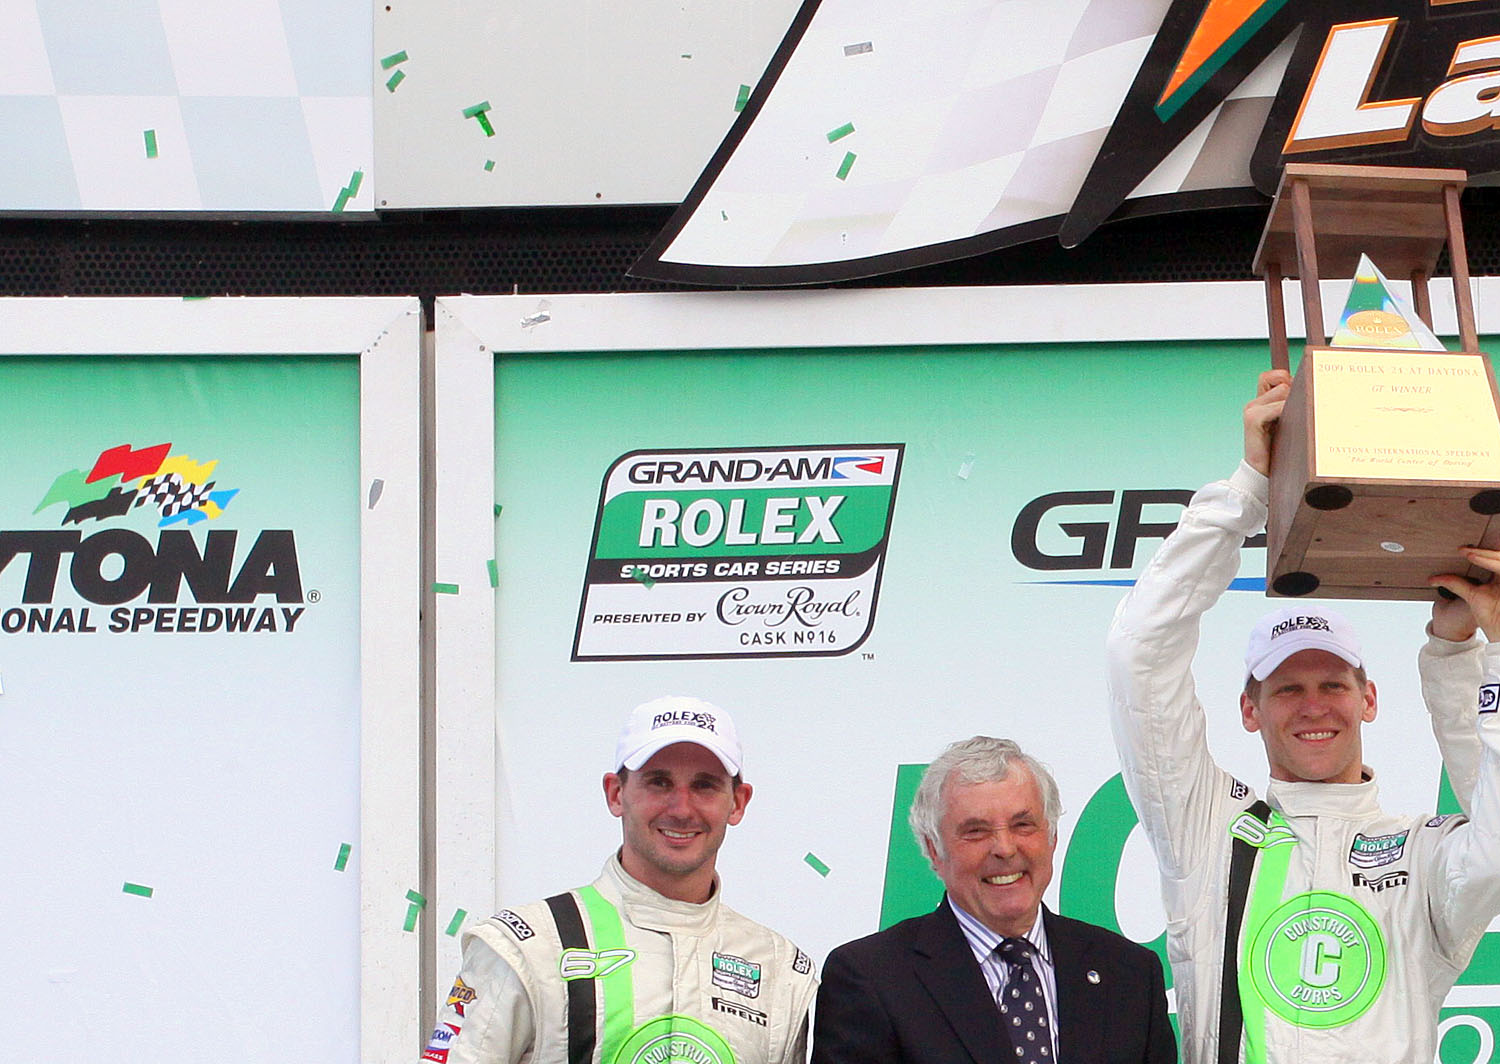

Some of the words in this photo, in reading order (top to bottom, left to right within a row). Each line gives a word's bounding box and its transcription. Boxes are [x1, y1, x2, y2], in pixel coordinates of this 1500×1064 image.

[1355, 324, 1402, 335] ROLEX
[1428, 368, 1479, 377] DAYTONA
[1390, 385, 1433, 394] WINNER
[638, 495, 848, 548] ROLEX
[714, 561, 762, 577] CAR
[764, 559, 841, 575] SERIES
[716, 587, 784, 626] Crown
[764, 586, 860, 627] Royal
[108, 606, 304, 633] SPEEDWAY
[593, 613, 680, 624] PRESENTED
[684, 612, 706, 623] BY
[1271, 616, 1314, 635] ROLEX
[740, 631, 786, 645] CASK
[653, 711, 700, 728] ROLEX
[1360, 840, 1398, 852] ROLEX
[1284, 916, 1360, 949] CONSTRUCT
[561, 950, 636, 978] 67
[719, 961, 753, 978] ROLEX
[1302, 934, 1343, 989] C
[1291, 984, 1343, 1005] CORPS
[711, 996, 768, 1027] PIRELLI
